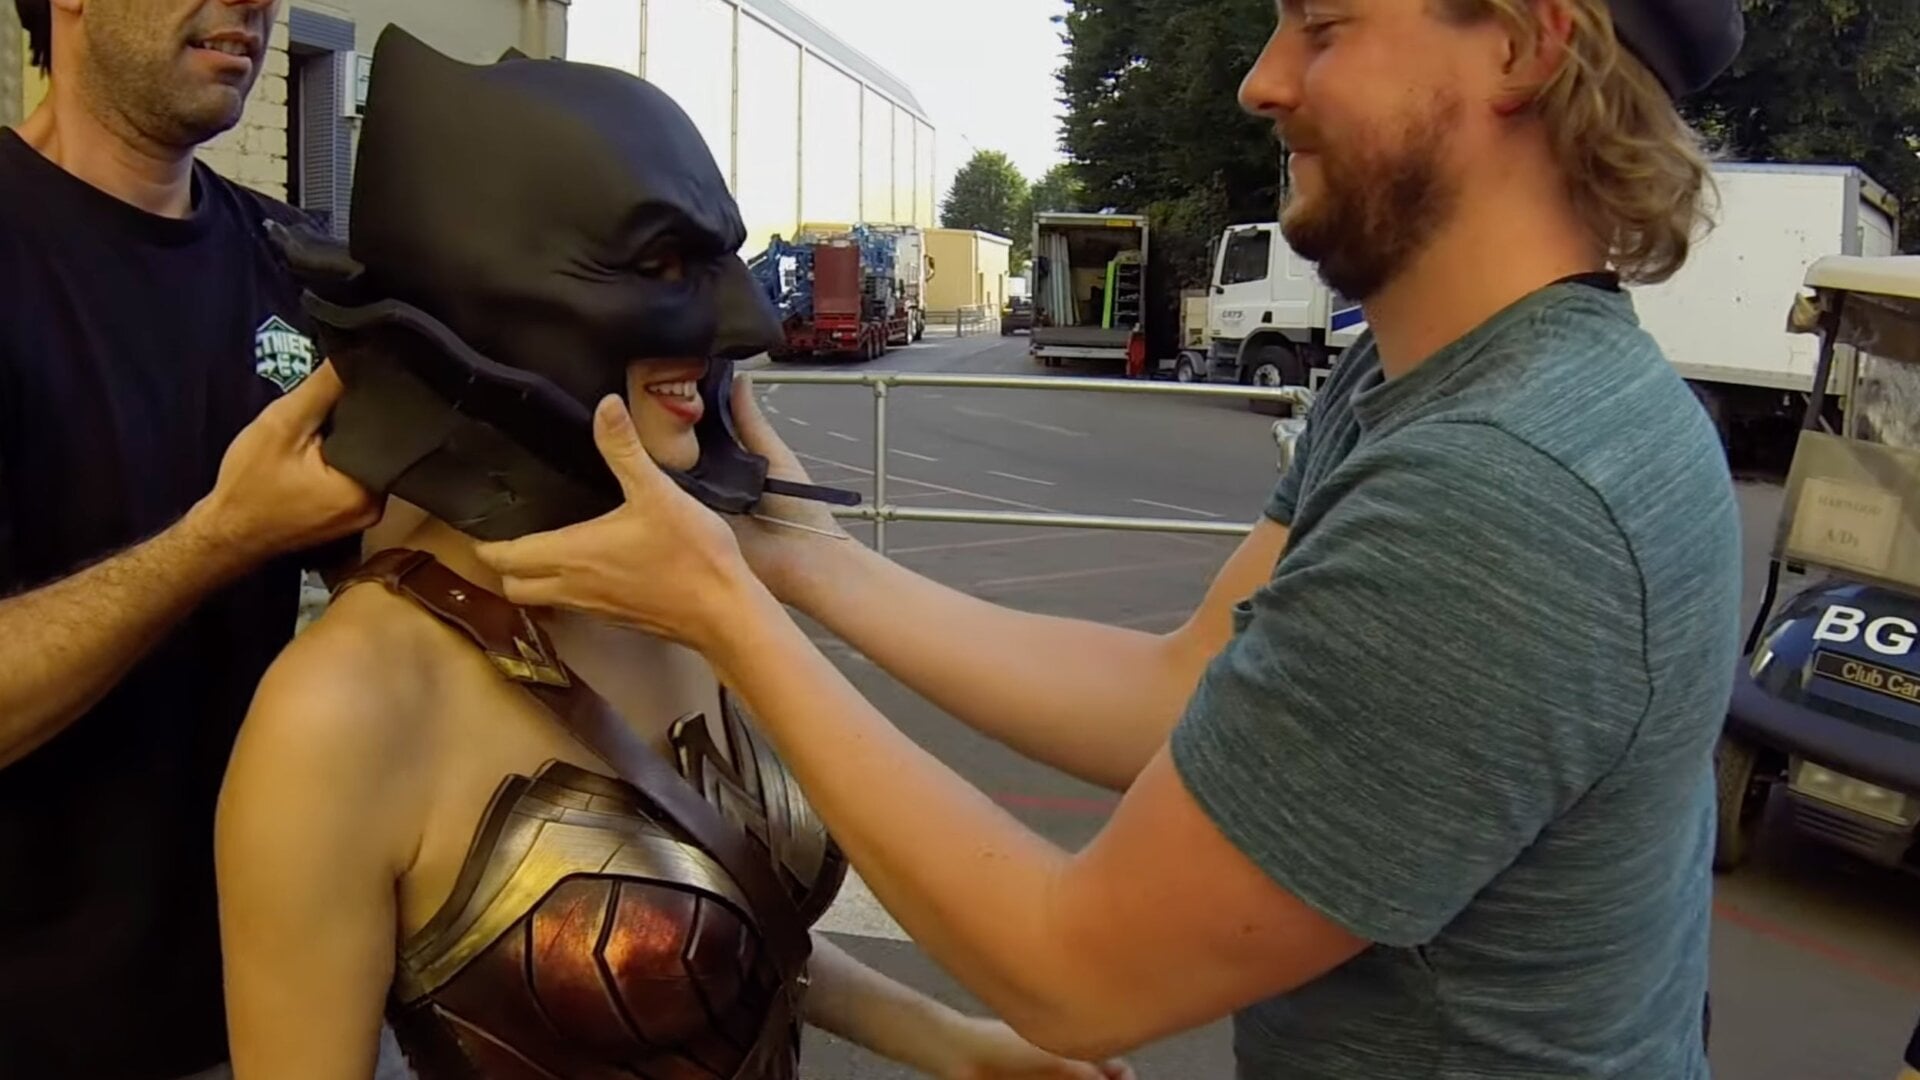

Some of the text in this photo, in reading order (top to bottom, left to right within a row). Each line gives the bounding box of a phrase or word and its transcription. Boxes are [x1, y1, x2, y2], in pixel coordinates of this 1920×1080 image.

[1812, 604, 1918, 656] BG
[1842, 661, 1920, 698] Club Car
